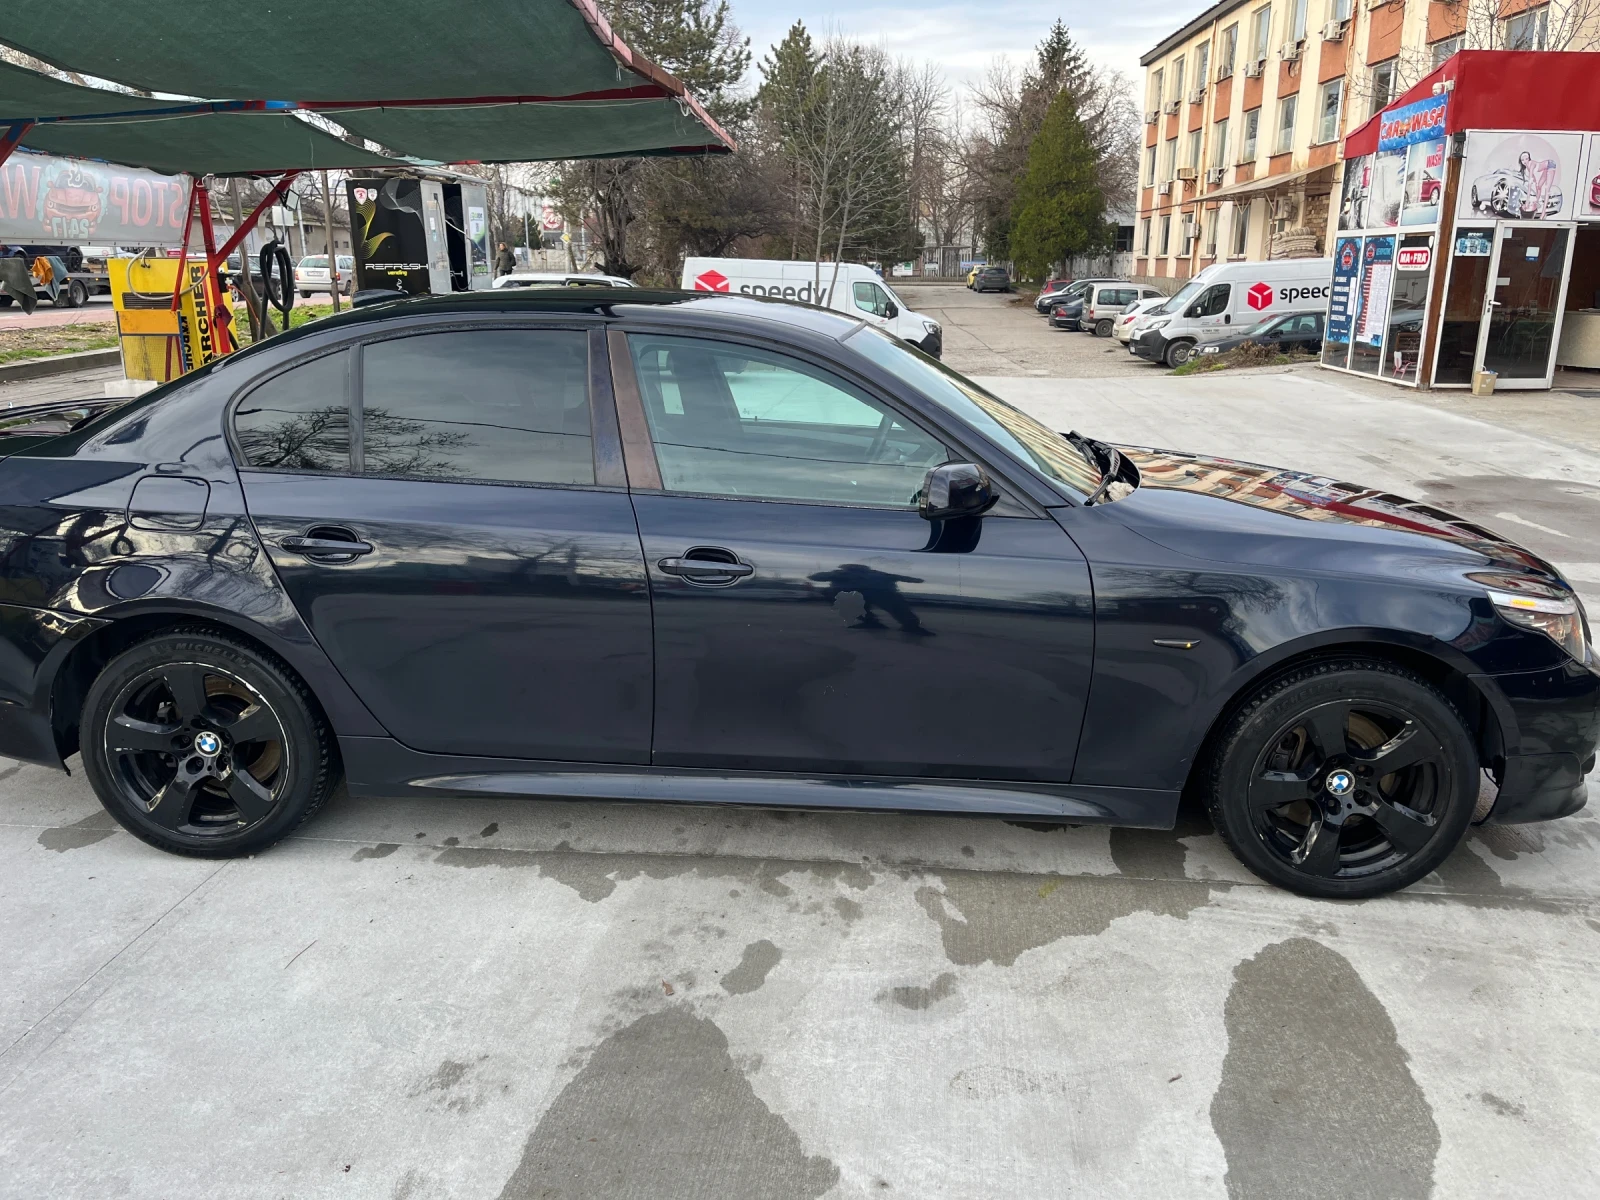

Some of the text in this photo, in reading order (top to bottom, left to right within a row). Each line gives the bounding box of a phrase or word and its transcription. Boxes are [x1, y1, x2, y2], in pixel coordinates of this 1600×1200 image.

[1380, 104, 1447, 141] CAR WASH
[1426, 153, 1443, 169] WASH
[365, 263, 429, 271] REFRESH
[190, 266, 213, 365] ÄRCHER
[180, 315, 194, 370] KÄRCHE
[175, 642, 247, 669] MICHELIN
